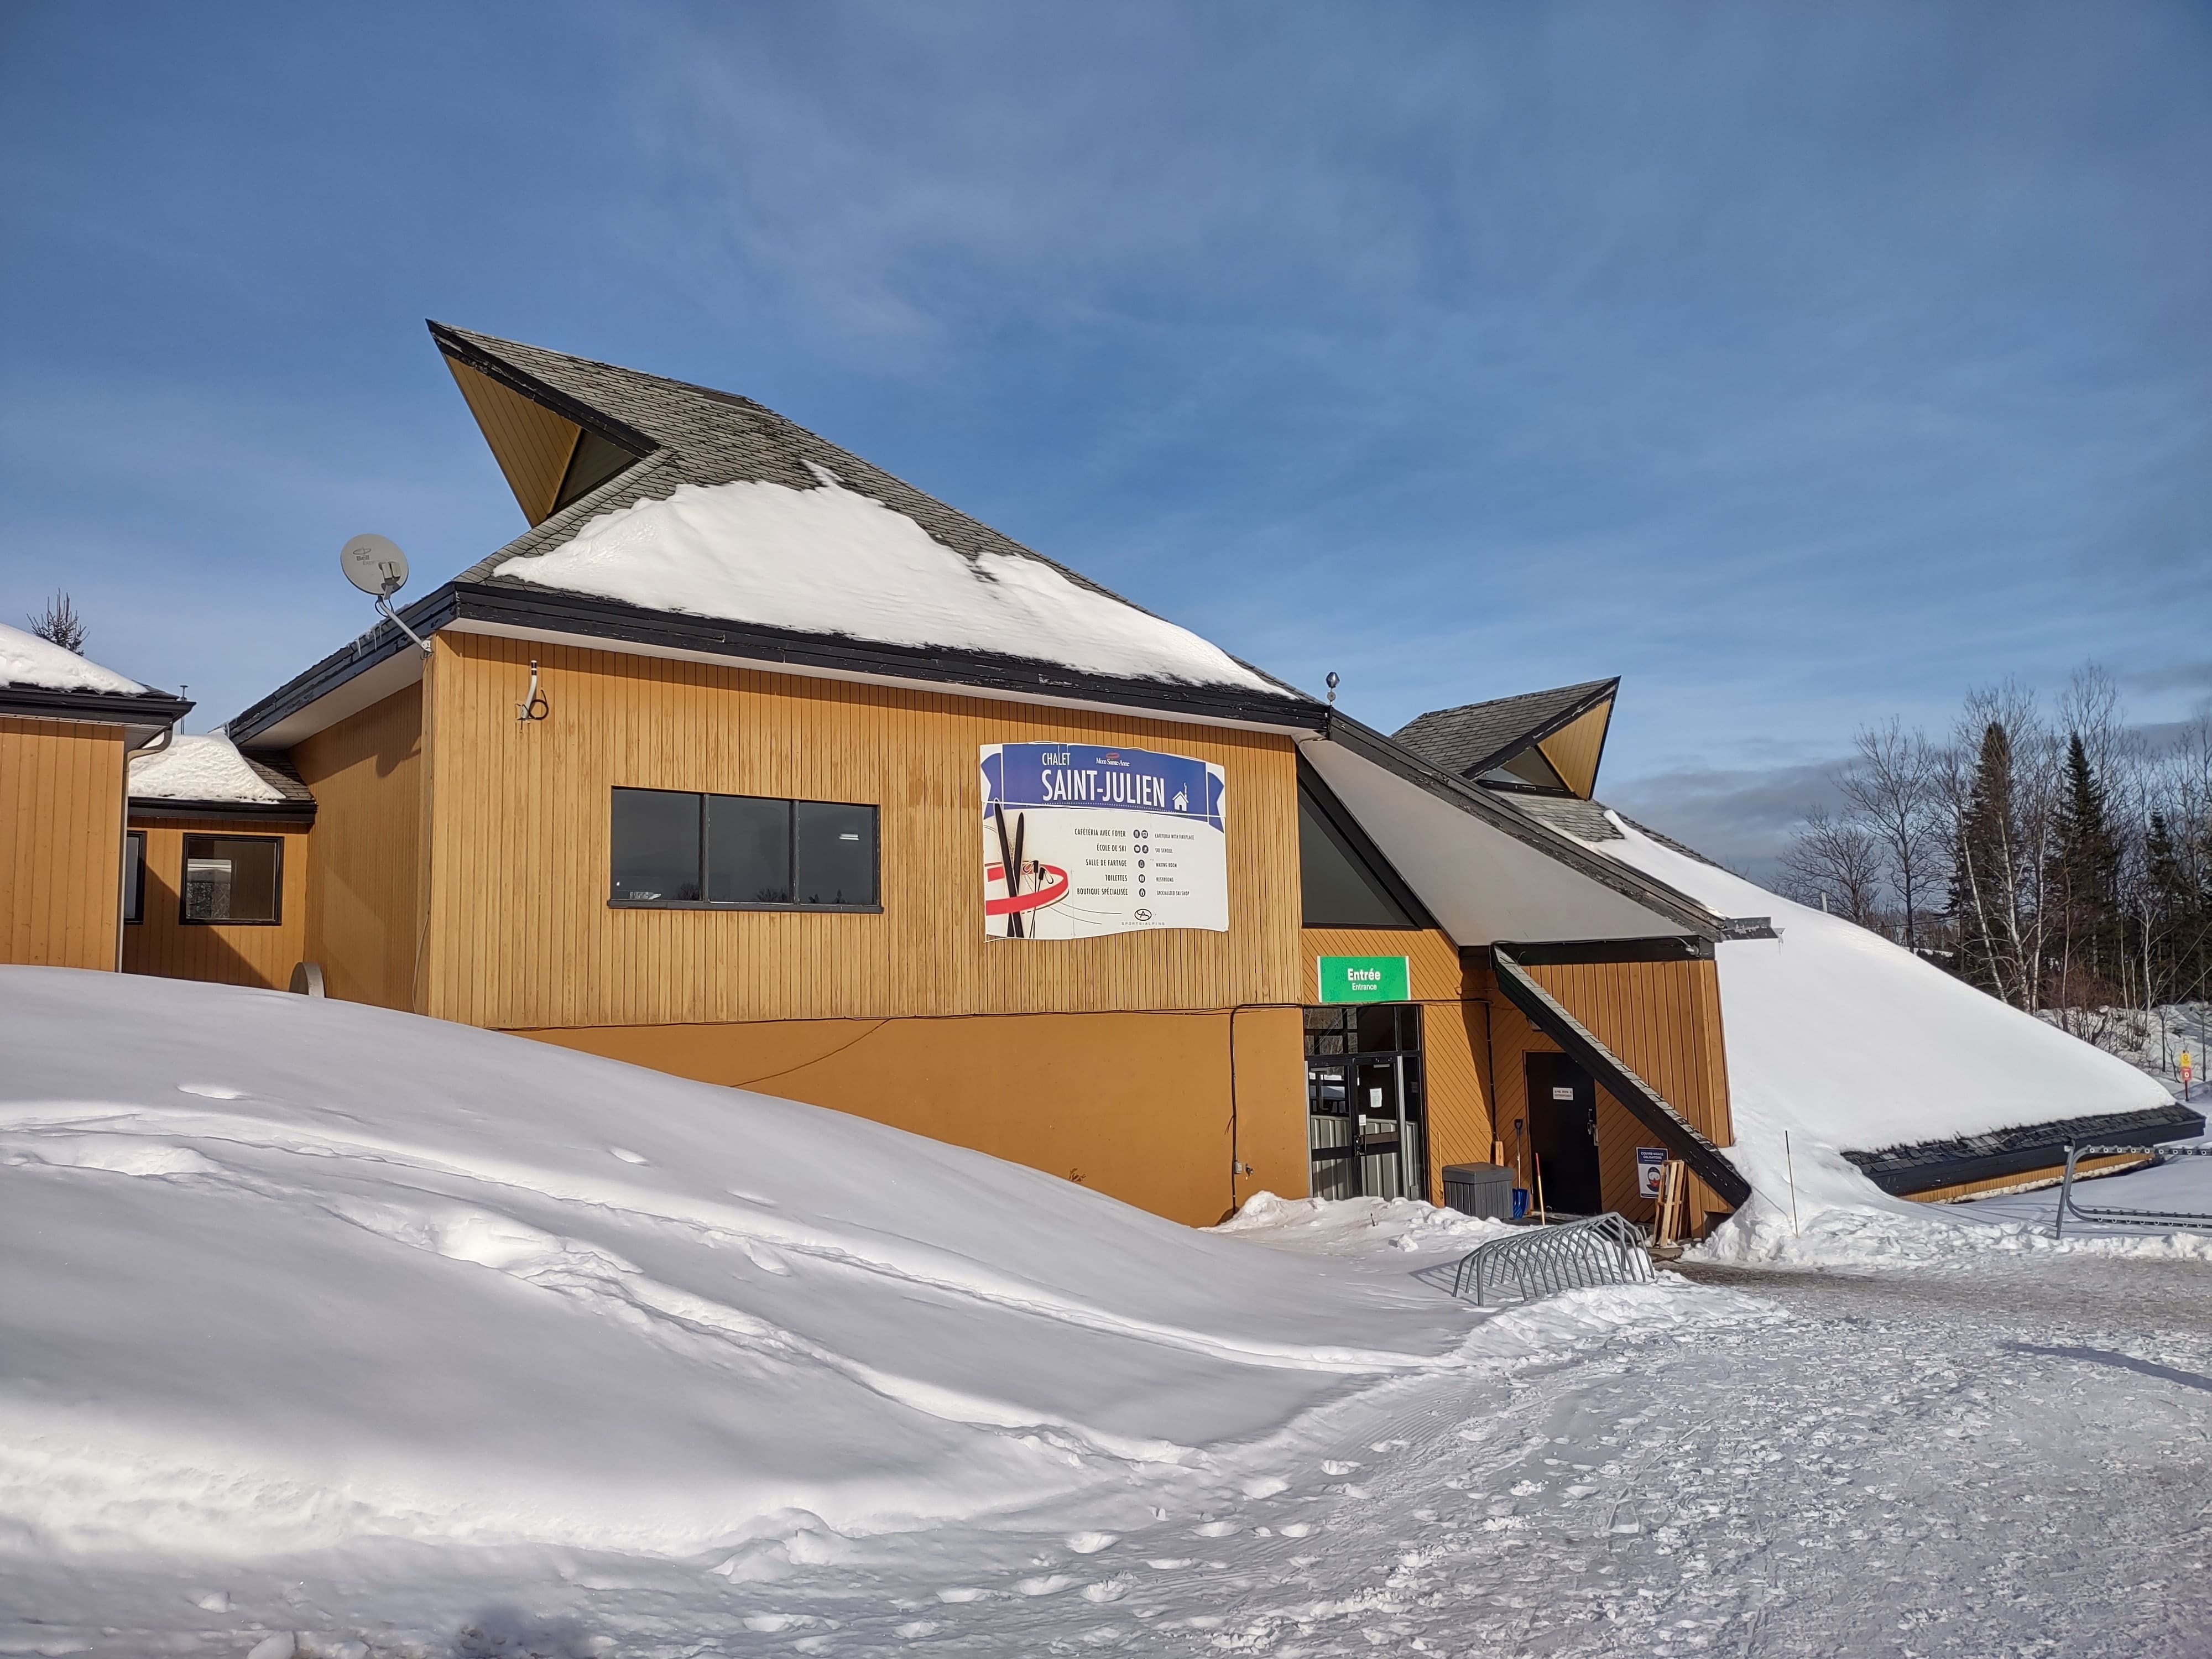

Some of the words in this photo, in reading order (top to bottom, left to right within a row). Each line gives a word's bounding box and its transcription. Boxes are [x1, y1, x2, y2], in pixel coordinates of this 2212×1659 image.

[1042, 752, 1071, 766] CHALET
[1095, 757, 1130, 767] Mont-Sainte-Anne
[1041, 769, 1165, 808] SAINT-JULIEN
[1074, 827, 1098, 836] CAFÉTÉRIA
[1097, 843, 1110, 851] ÉCOLE
[1101, 886, 1128, 895] SPÉCIALISÉE
[1348, 968, 1381, 981] Entrée
